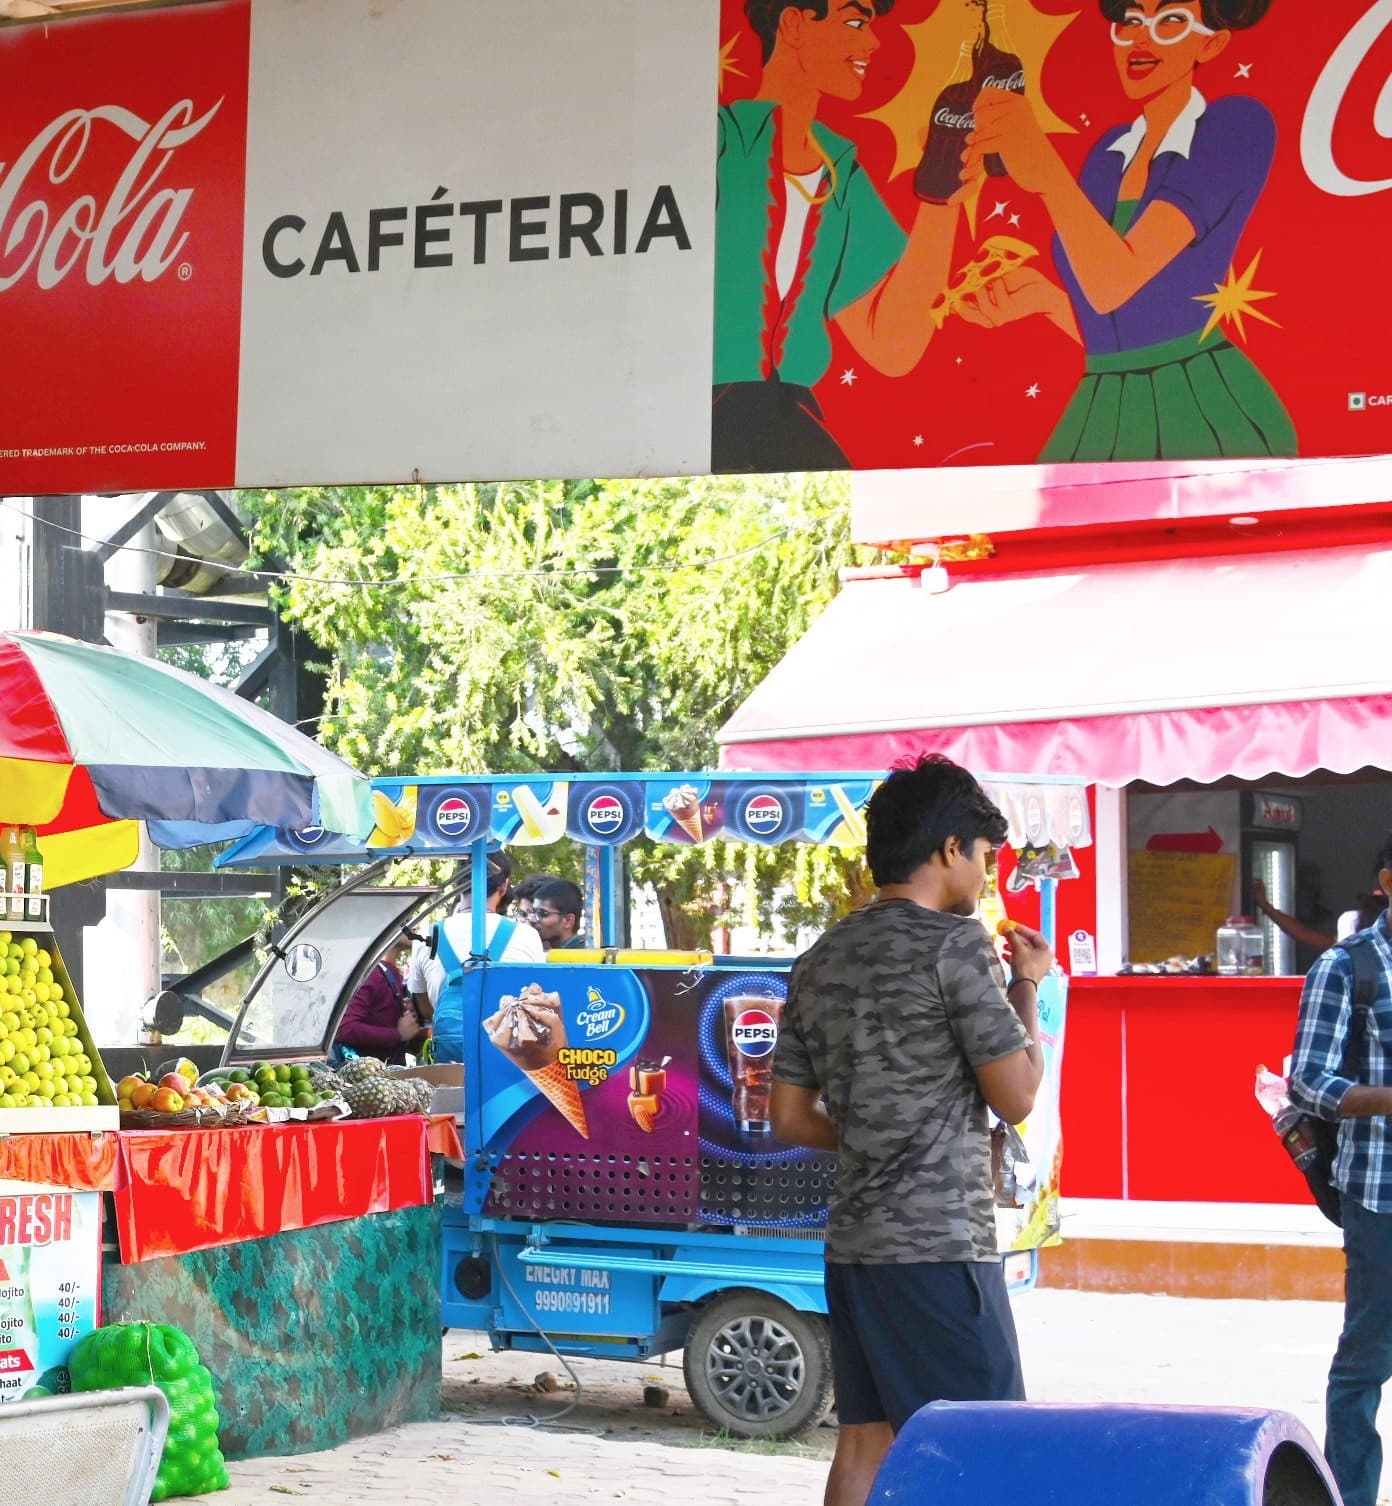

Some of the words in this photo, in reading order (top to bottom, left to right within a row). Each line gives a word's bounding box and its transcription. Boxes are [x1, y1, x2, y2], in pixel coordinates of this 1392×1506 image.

[261, 184, 693, 279] CAFÉTERIA
[21, 447, 74, 458] TRADEMARK
[75, 446, 88, 456] OF
[89, 445, 107, 455] THE
[159, 441, 207, 452] COMPANY.
[438, 812, 469, 822] PEPSI
[590, 810, 622, 819] PEPSI
[747, 810, 781, 819] PEPSI
[576, 1009, 616, 1025] Cream
[586, 1019, 610, 1037] Bell
[734, 1027, 777, 1040] PEPSI
[558, 1048, 617, 1065] CHOCO
[566, 1064, 608, 1086] Fudge
[58, 1282, 80, 1294] 40/-
[58, 1297, 80, 1309] 40/-
[58, 1312, 80, 1324] 40/-
[58, 1327, 80, 1339] 40/-
